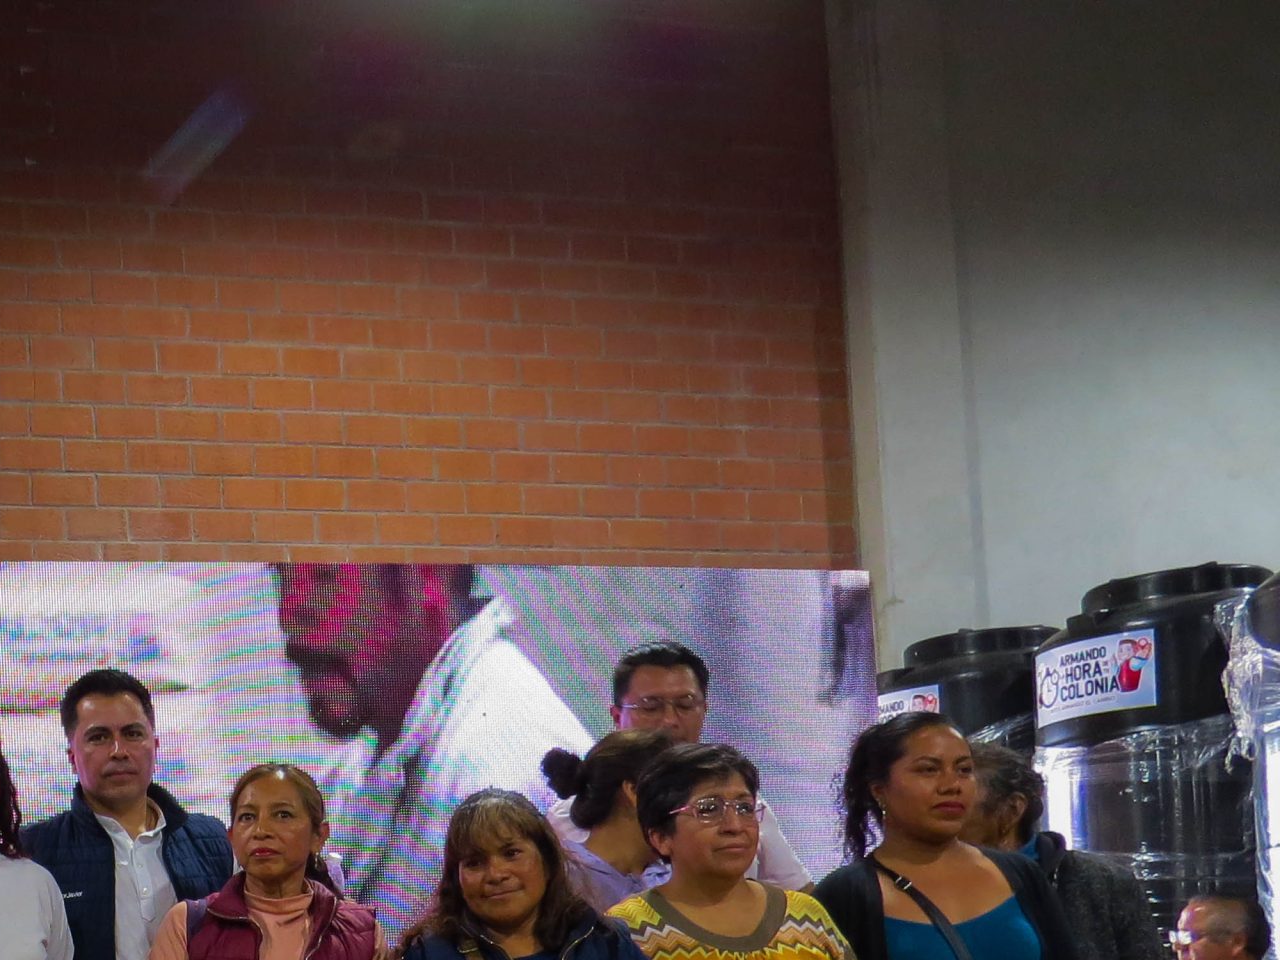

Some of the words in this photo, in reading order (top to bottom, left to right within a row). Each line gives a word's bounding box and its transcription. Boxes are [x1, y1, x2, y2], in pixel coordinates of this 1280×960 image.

[1060, 646, 1107, 668] ARMANDO
[1065, 661, 1103, 684] HORA
[1060, 675, 1121, 702] COLONIA
